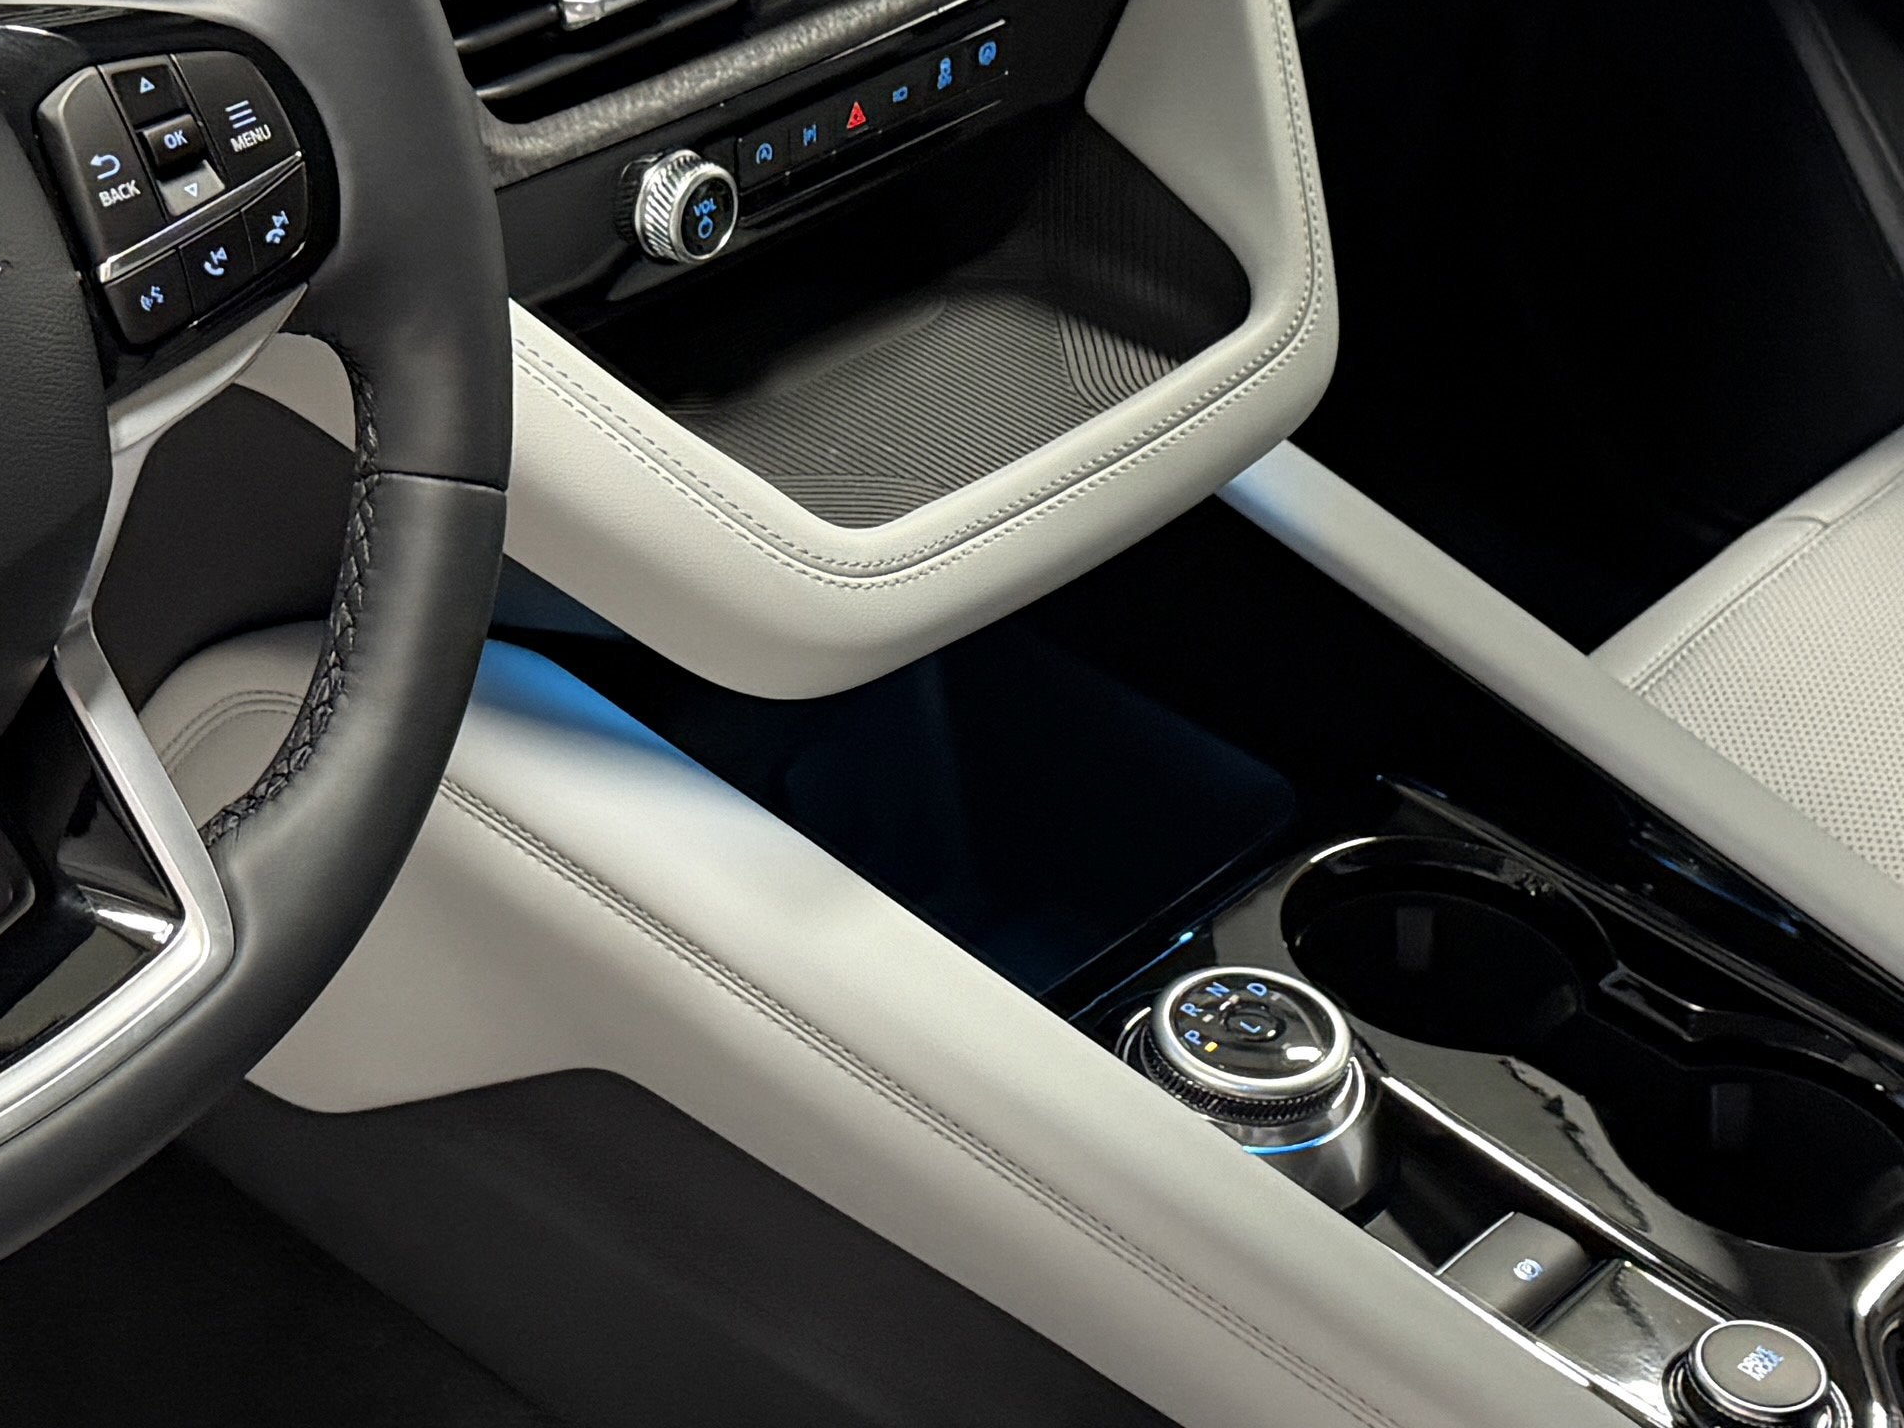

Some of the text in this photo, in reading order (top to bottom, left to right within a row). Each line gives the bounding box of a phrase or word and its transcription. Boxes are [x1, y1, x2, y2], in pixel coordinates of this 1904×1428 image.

[163, 128, 188, 150] OK
[230, 124, 272, 154] MENU
[99, 179, 141, 209] BACK
[693, 198, 717, 217] VOL
[1206, 982, 1229, 998] N
[1246, 982, 1267, 997] D
[1180, 1002, 1203, 1018] R
[1239, 1020, 1261, 1034] L
[1185, 1030, 1202, 1046] P
